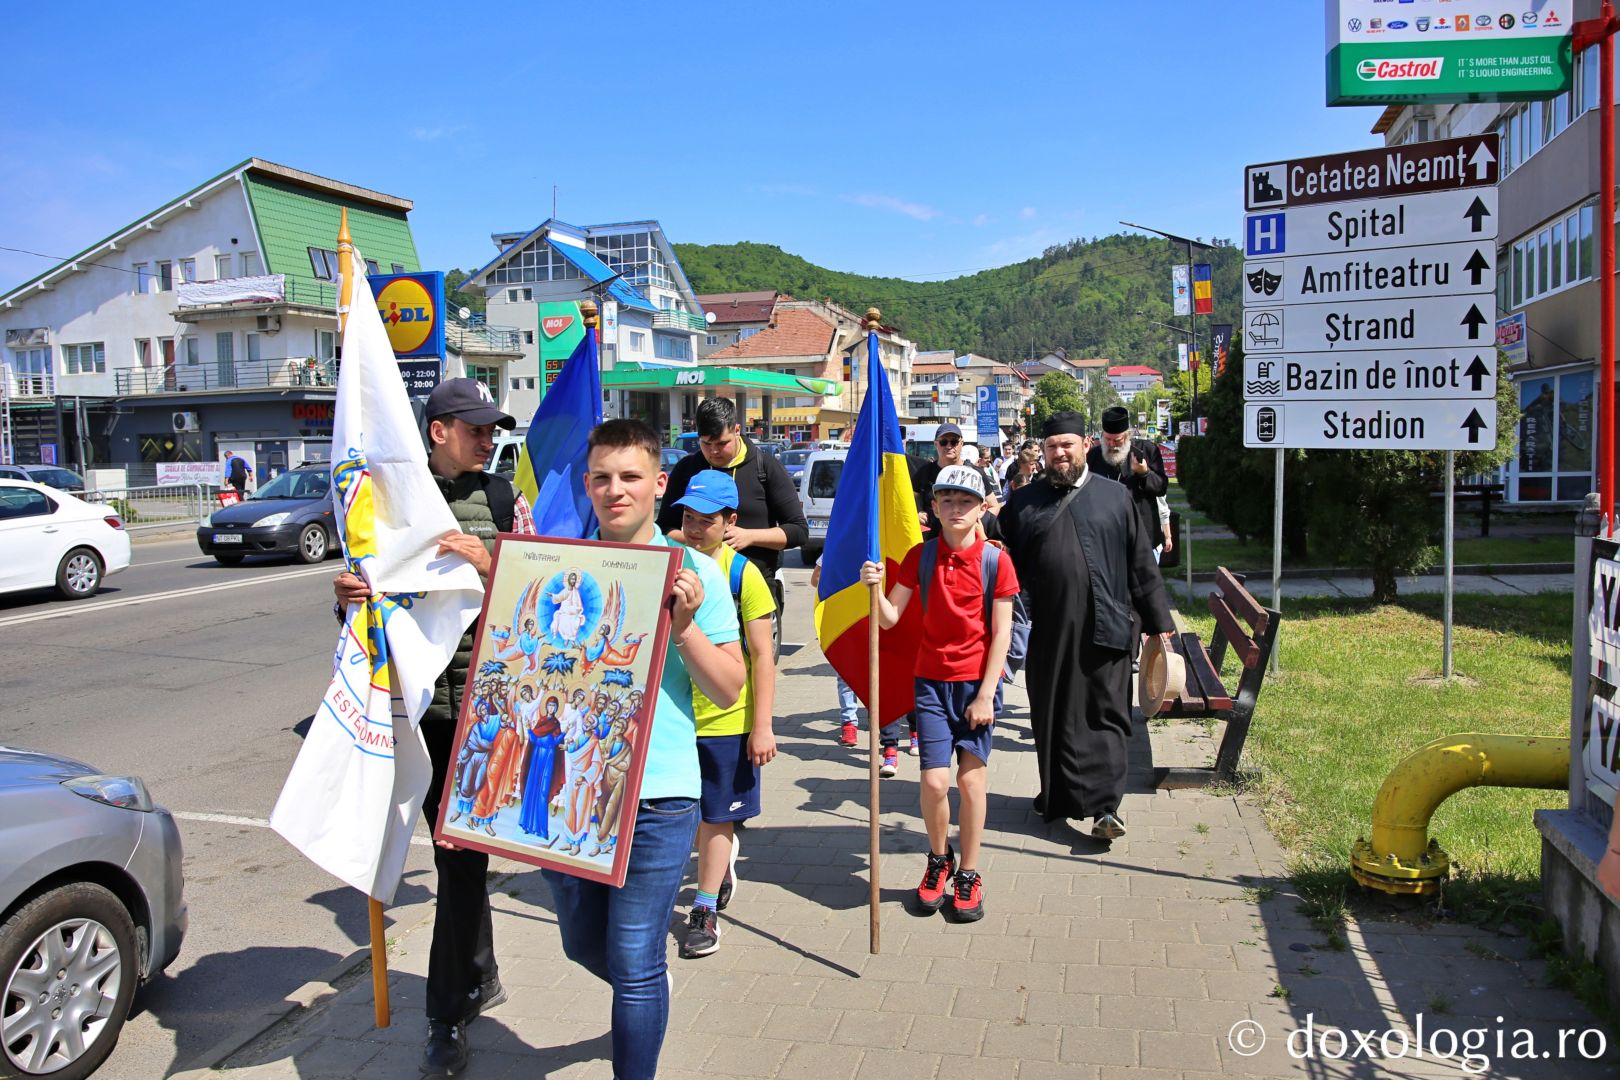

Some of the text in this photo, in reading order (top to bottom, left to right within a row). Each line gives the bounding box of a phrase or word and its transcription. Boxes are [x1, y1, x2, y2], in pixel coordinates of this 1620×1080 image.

[1377, 59, 1437, 78] Castrol
[1475, 56, 1497, 66] MORE
[1499, 56, 1518, 65] THAN
[1520, 55, 1539, 65] JUST
[1540, 55, 1555, 64] OIL.
[1476, 67, 1500, 78] LIQUID
[1291, 145, 1467, 197] Cetatea Neamț
[1255, 217, 1277, 251] H
[1327, 204, 1405, 247] Spital
[1301, 257, 1449, 295] Amfiteatru
[546, 319, 563, 328] MOL
[1325, 308, 1415, 350] Ștrand
[414, 380, 434, 388] 20:00
[416, 370, 436, 378] 22:00
[676, 370, 705, 385] MOL
[1286, 358, 1460, 391] Bazin de înot
[1324, 409, 1425, 440] Stadion
